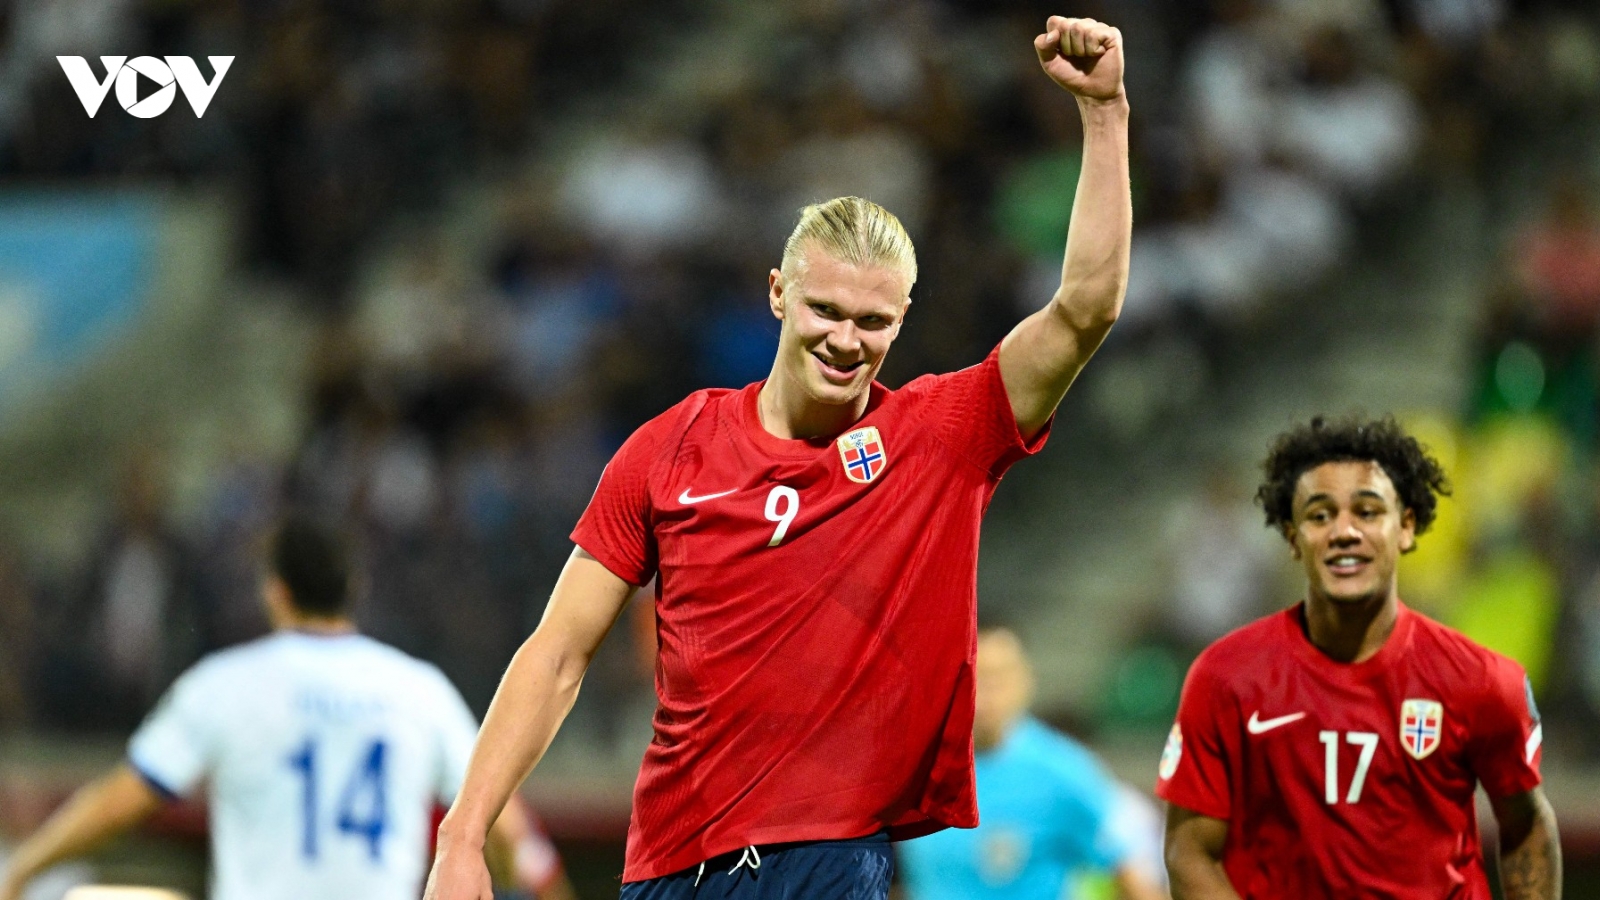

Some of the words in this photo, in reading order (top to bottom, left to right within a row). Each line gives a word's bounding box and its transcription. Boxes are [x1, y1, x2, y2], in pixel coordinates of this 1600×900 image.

[764, 485, 800, 547] 9
[287, 737, 389, 860] 14
[1319, 730, 1379, 805] 17
